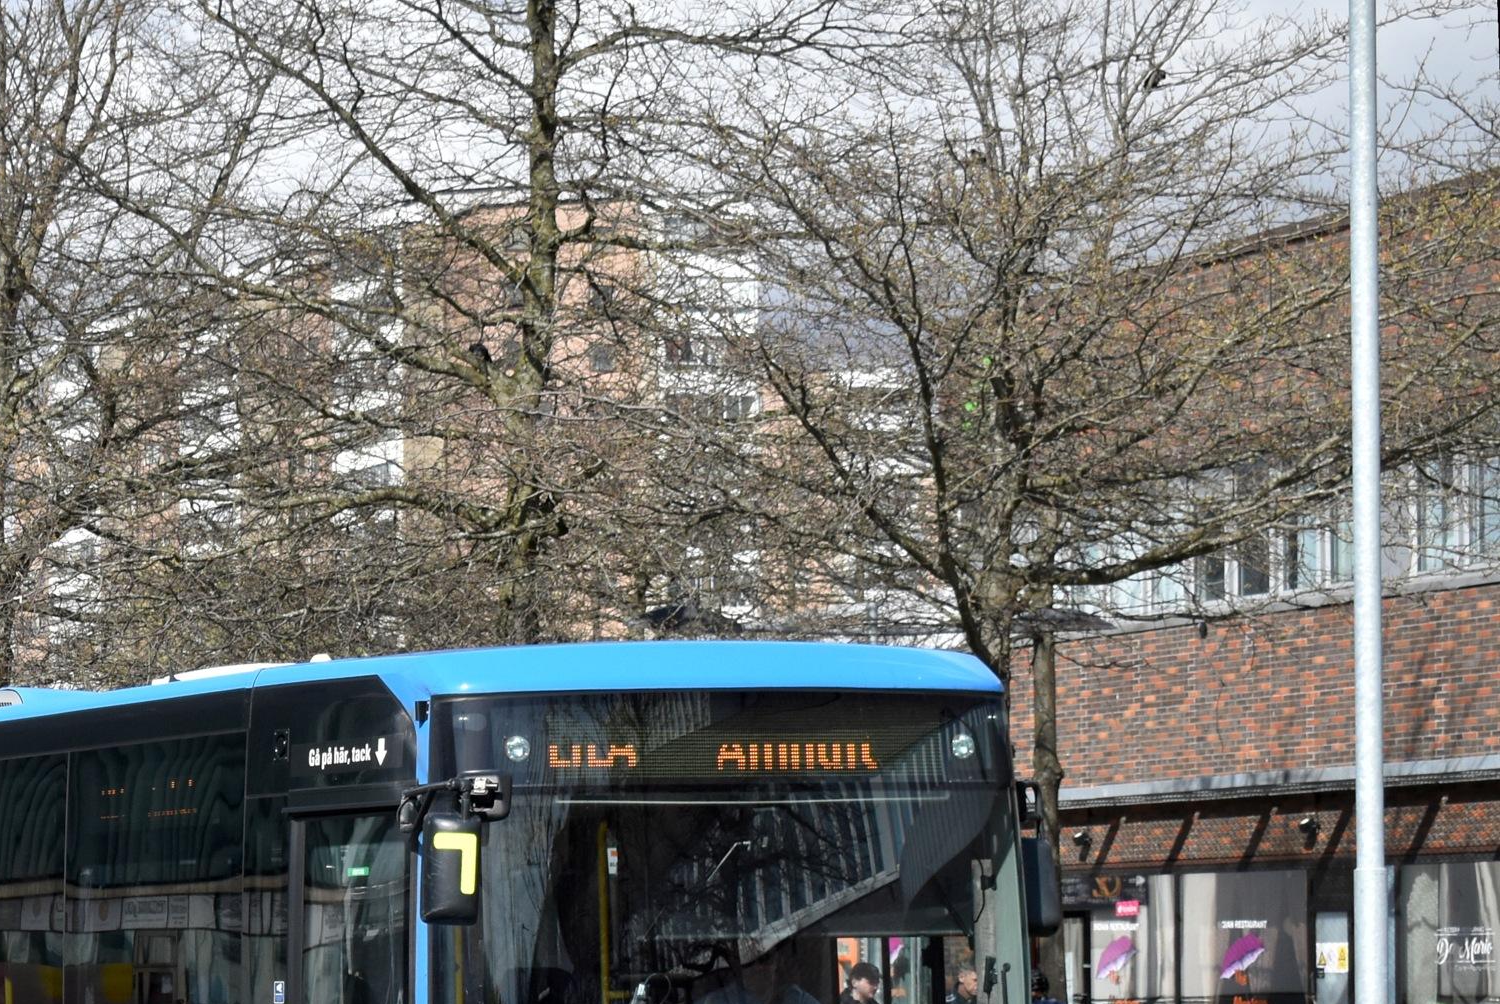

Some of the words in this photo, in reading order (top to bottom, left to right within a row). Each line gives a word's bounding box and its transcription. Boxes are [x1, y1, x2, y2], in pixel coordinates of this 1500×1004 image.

[309, 748, 320, 766] Gå
[321, 746, 333, 770] på
[333, 746, 351, 765] här,
[352, 743, 371, 762] tack
[1234, 919, 1268, 929] RESTAURANT
